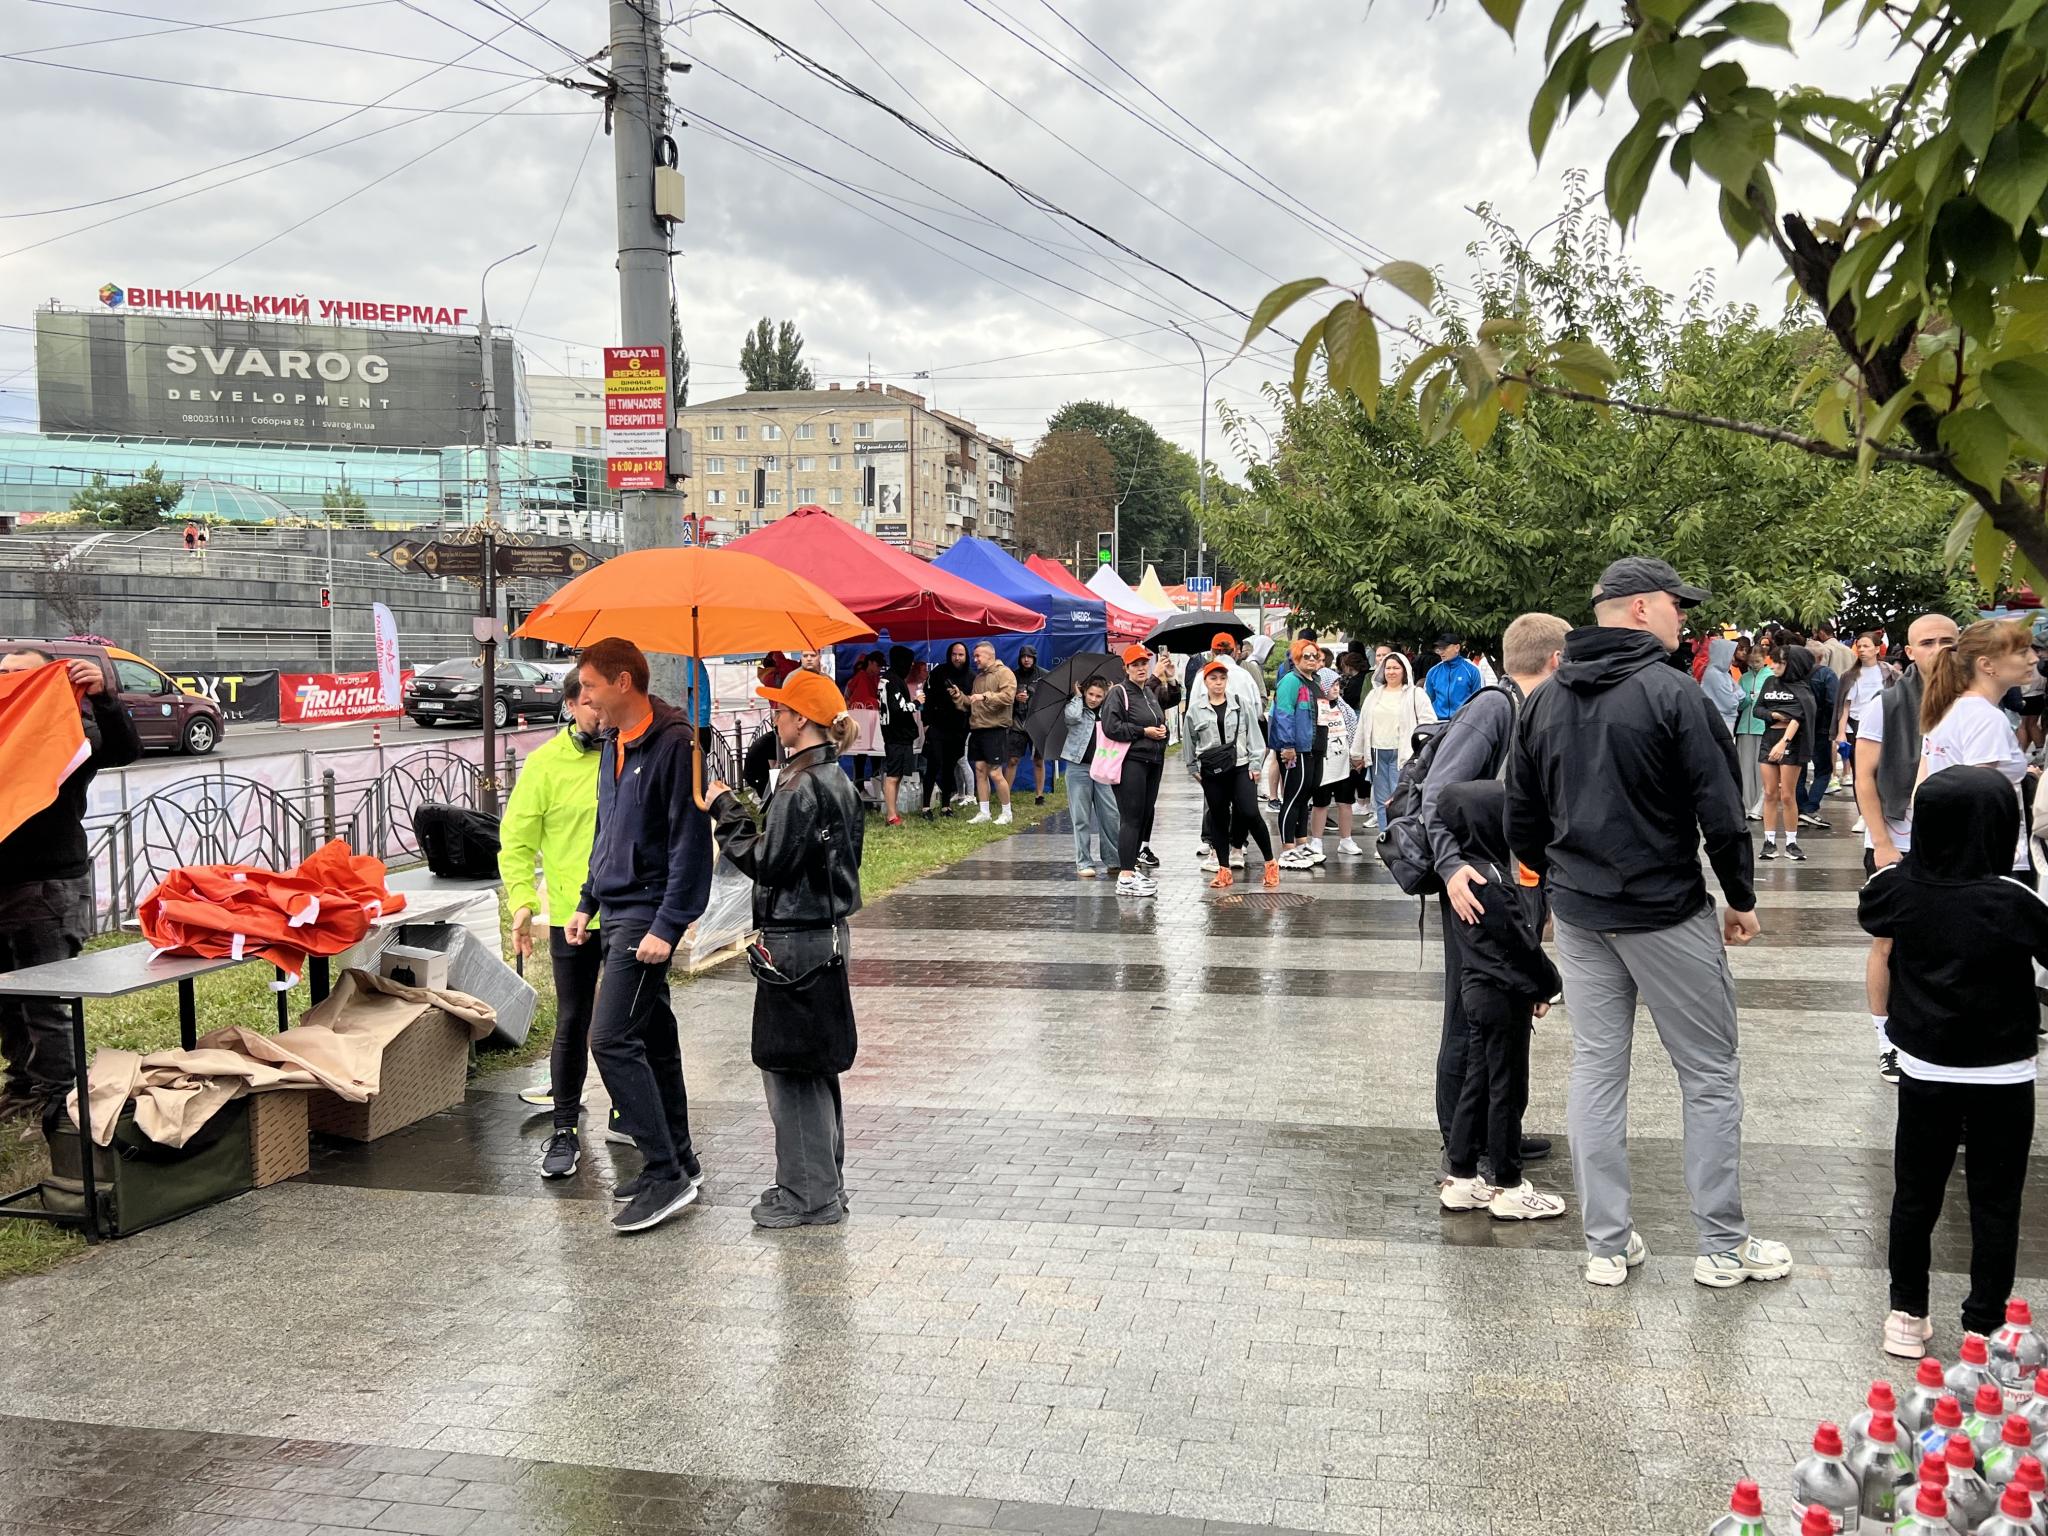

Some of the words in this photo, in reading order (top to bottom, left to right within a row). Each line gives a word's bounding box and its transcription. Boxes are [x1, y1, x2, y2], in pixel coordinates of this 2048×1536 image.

[127, 287, 310, 319] ВІННИЦЬКИЙ
[318, 299, 468, 326] УНІВЕРМАГ
[612, 349, 649, 358] УВАГА
[166, 345, 389, 384] SVAROG
[628, 358, 641, 369] 6
[612, 369, 660, 378] ВЕРЕСНЯ
[168, 389, 389, 410] DEVELOPMENT
[617, 398, 662, 410] ТИМЧАСОВЕ
[182, 414, 235, 424] 0800351111
[251, 416, 292, 427] Соборна
[293, 418, 305, 427] 82
[322, 420, 376, 431] svarog.in.ua
[609, 414, 656, 426] ПЕРЕКРИТТЯ
[617, 461, 632, 472] 6:00
[633, 463, 643, 474] до
[644, 460, 663, 471] 14:30
[176, 676, 244, 703] EXT
[306, 706, 345, 718] NATIONAL
